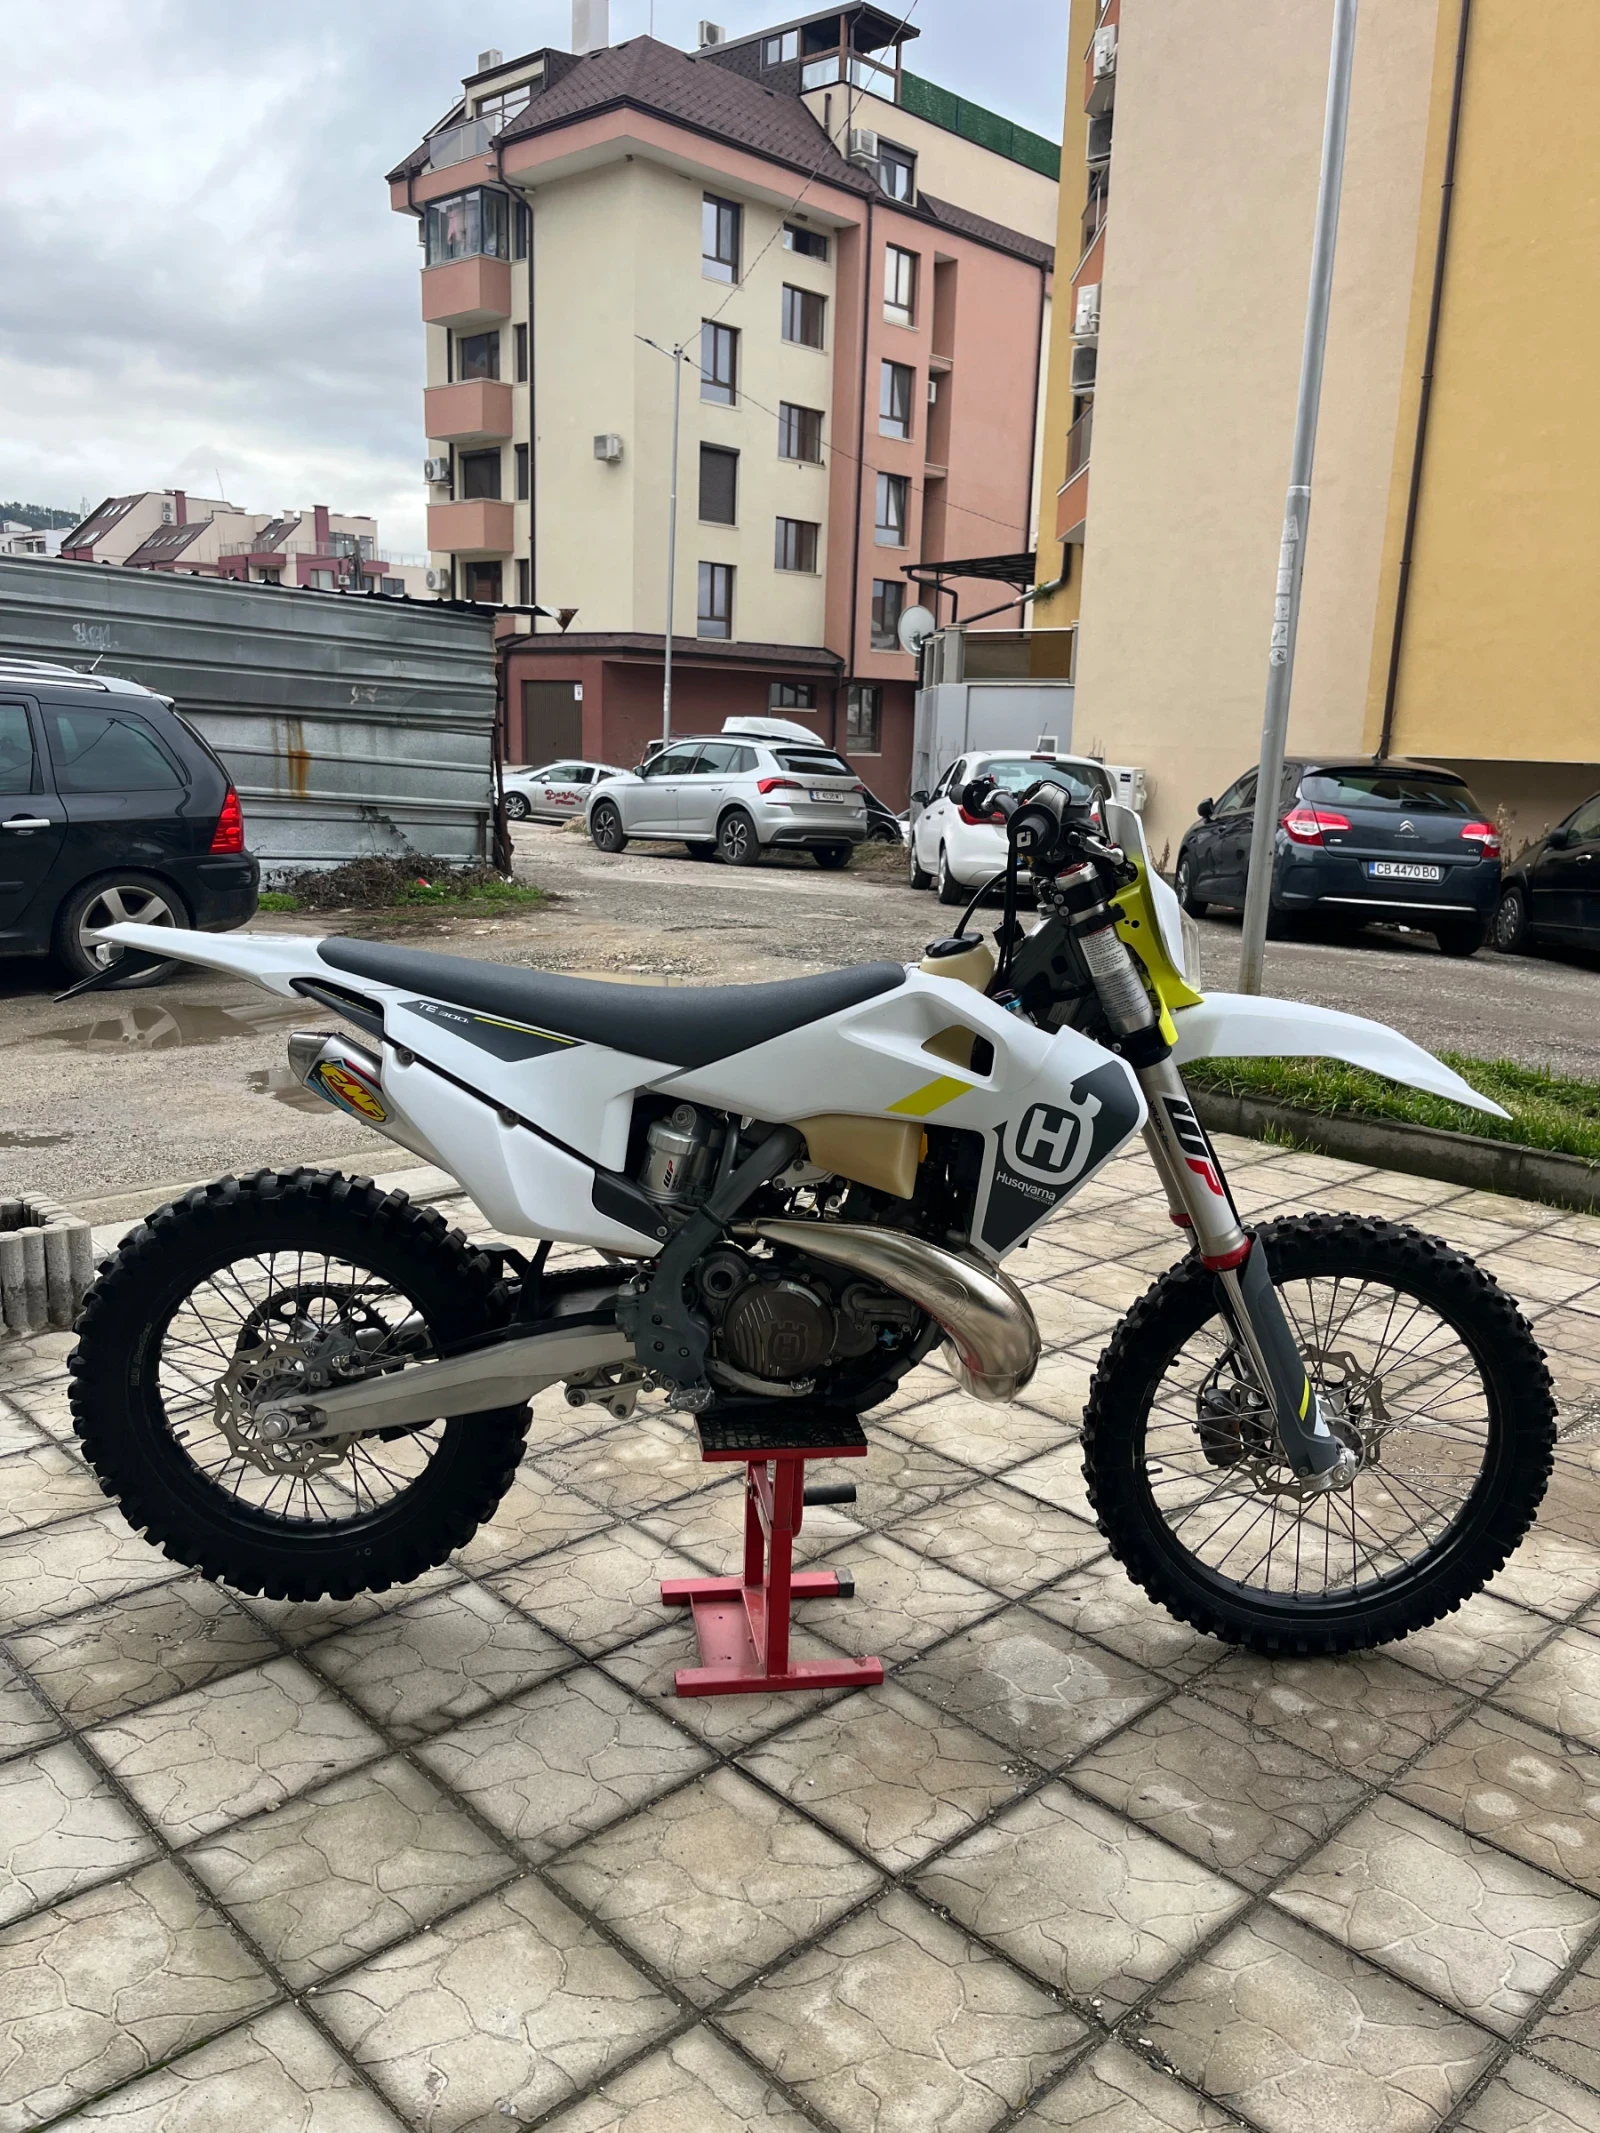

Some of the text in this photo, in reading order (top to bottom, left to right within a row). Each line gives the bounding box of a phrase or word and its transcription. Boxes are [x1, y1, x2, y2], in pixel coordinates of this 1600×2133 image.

[1376, 863, 1392, 875] CB
[1394, 865, 1420, 877] 4470
[419, 1002, 438, 1013] TE
[319, 1063, 389, 1119] FMF
[1021, 1108, 1075, 1167] H
[995, 1171, 1056, 1201] Husqvarna
